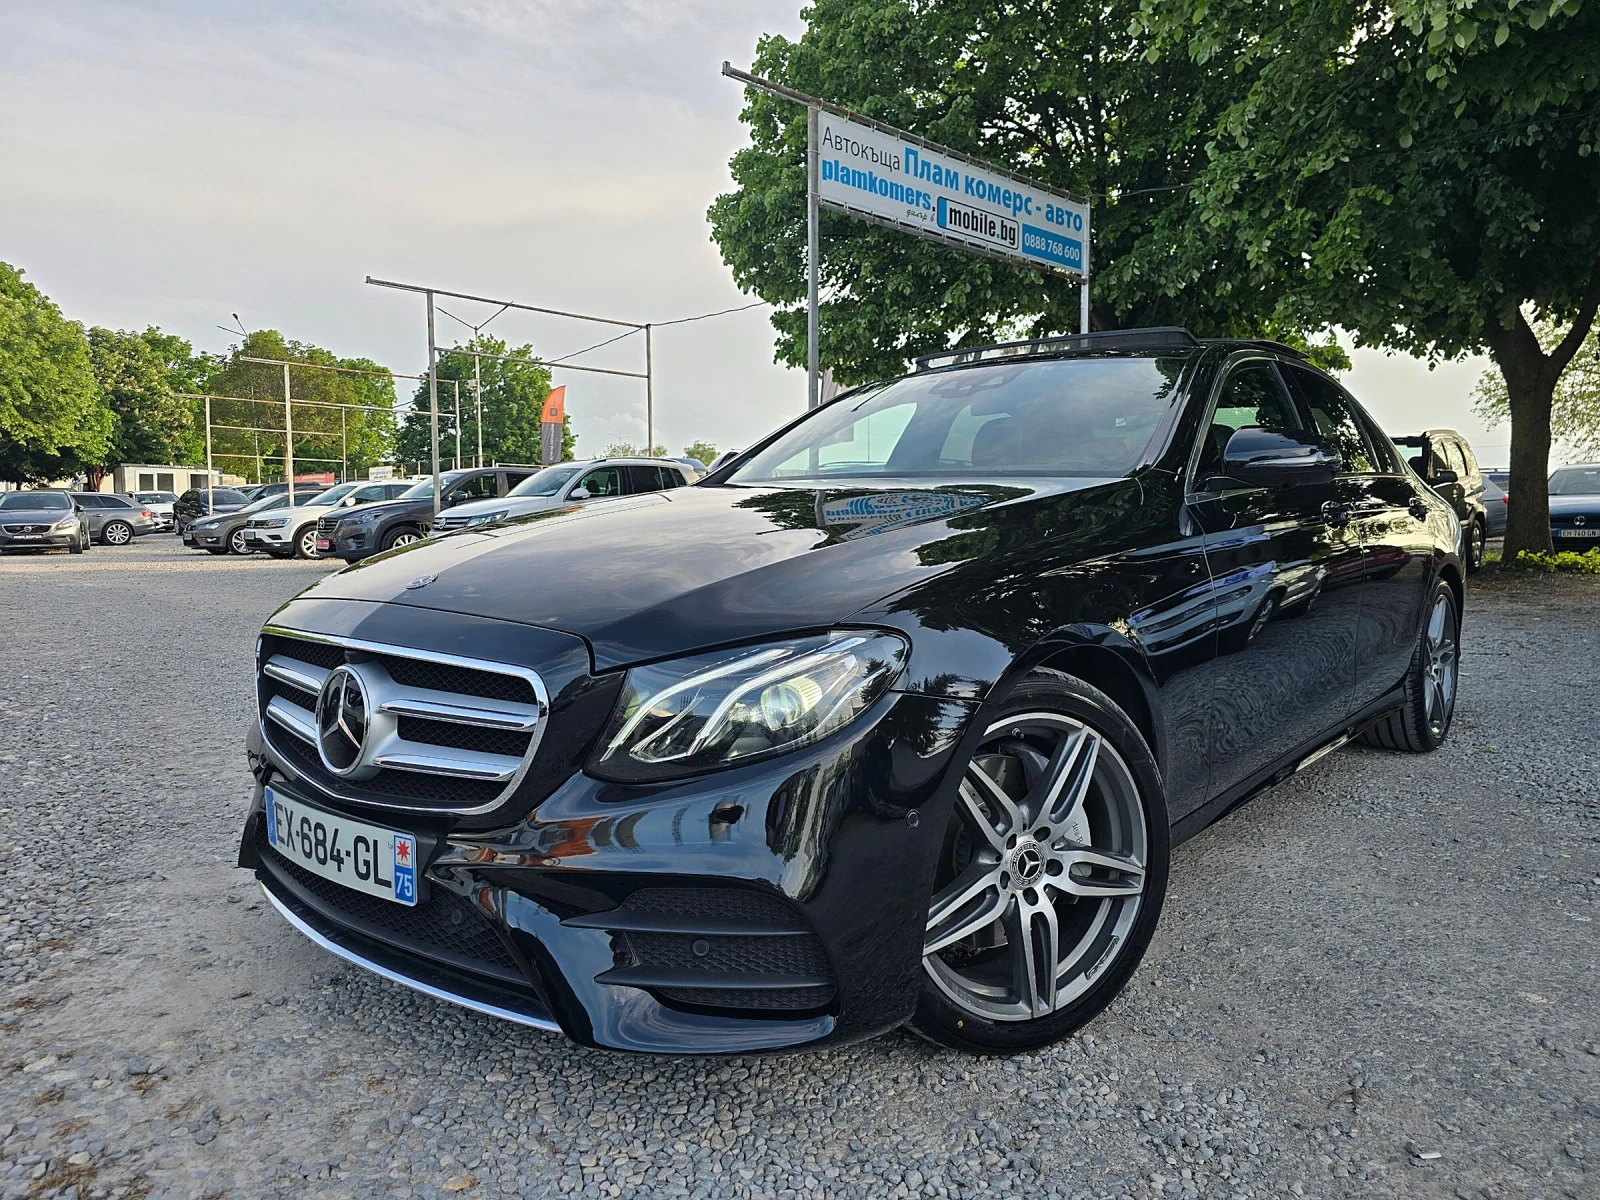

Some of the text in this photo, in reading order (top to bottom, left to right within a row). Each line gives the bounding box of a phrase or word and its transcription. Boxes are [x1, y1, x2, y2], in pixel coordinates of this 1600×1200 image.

[822, 126, 900, 172] Автокъща
[904, 147, 959, 191] Плам
[964, 175, 1032, 217] комерс
[1045, 203, 1083, 232] авто
[949, 207, 1016, 246] mobile.bg
[1024, 233, 1080, 261] 0888 768 600
[274, 801, 392, 889] EX-684-GL
[395, 872, 413, 897] 75
